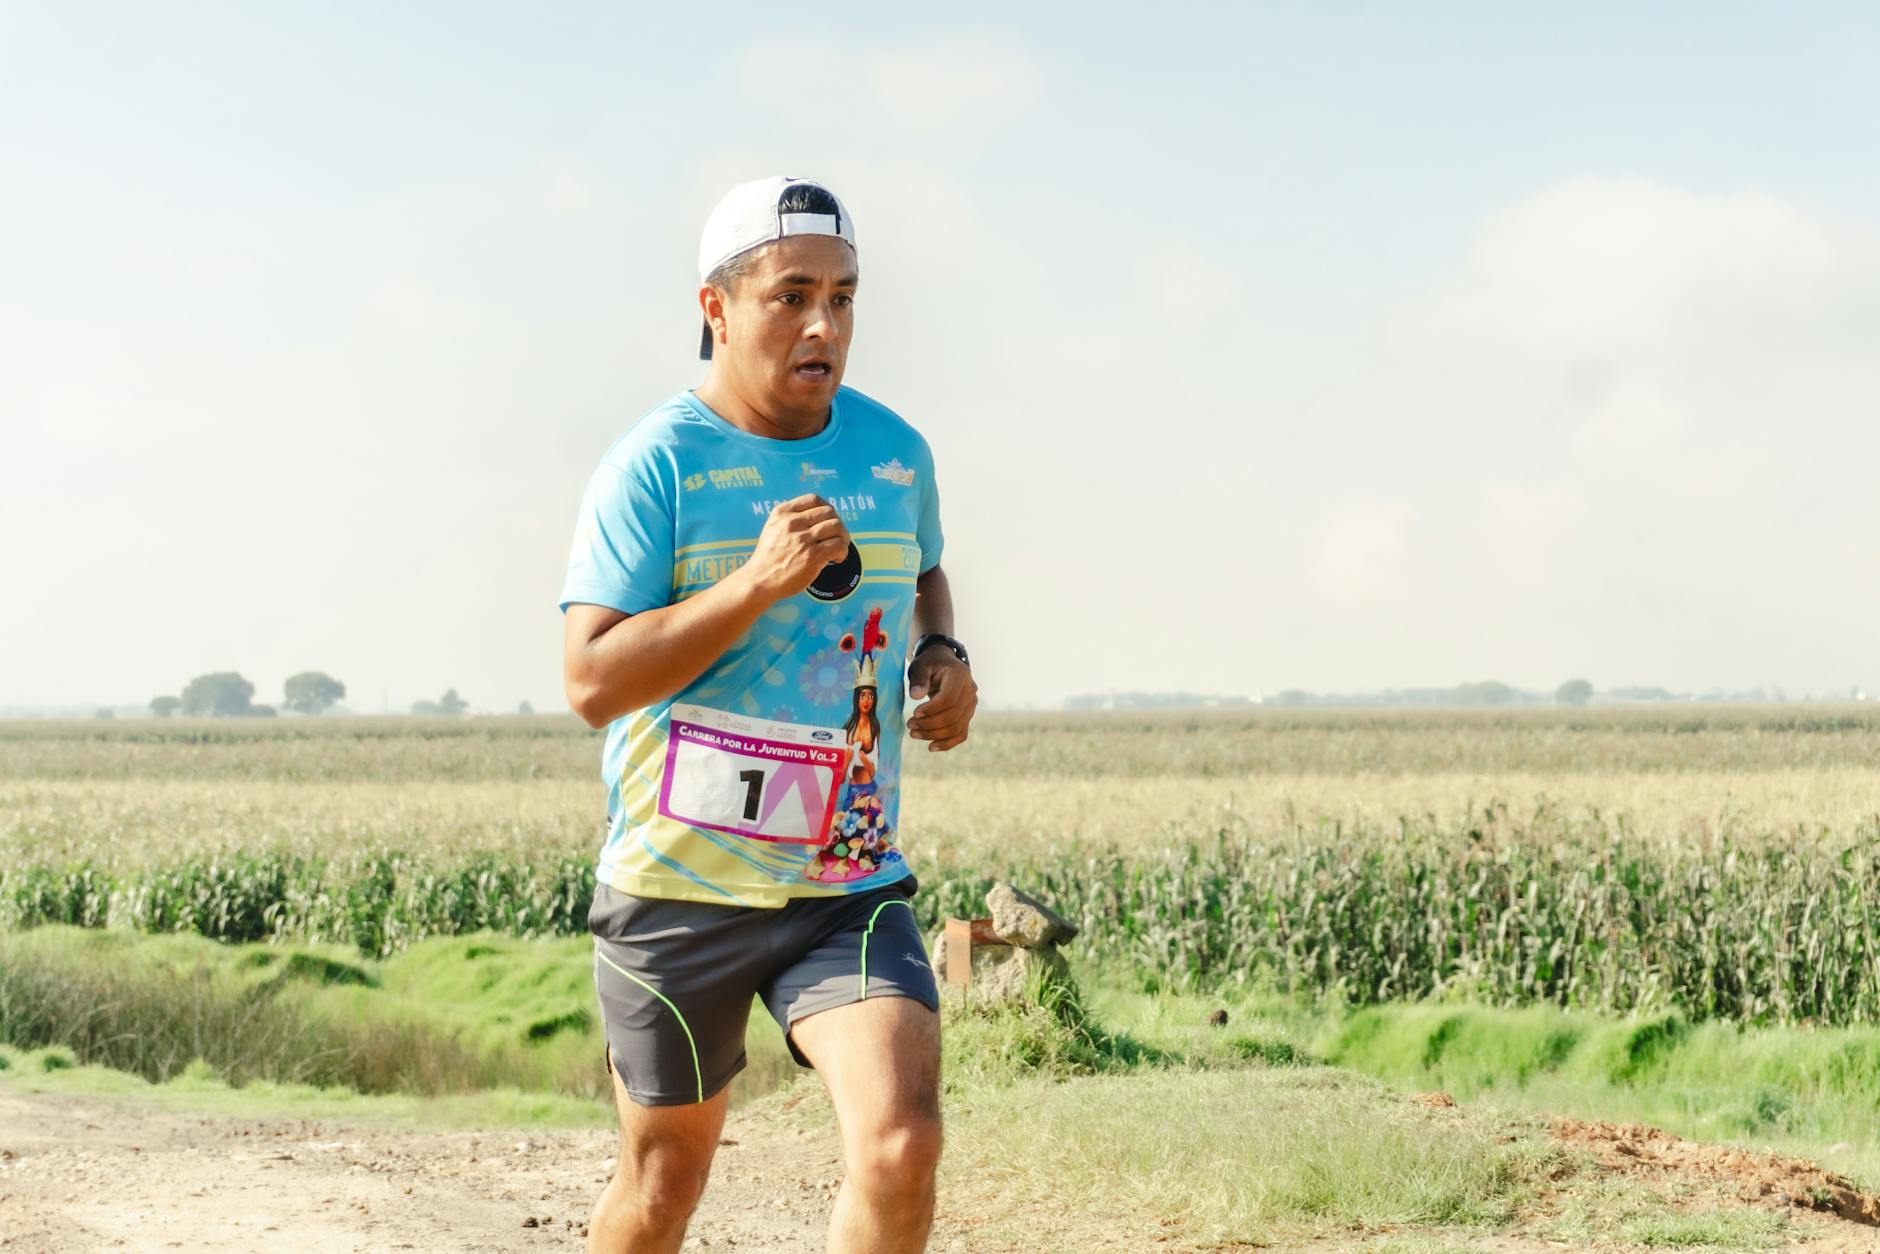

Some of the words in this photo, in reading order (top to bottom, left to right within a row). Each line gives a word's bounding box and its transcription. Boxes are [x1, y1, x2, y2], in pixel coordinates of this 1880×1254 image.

[708, 466, 762, 483] CAPITAL
[828, 492, 876, 511] RATÓN
[679, 725, 721, 744] CARRERA
[722, 738, 742, 749] POR
[743, 742, 756, 752] LA
[758, 743, 807, 759] JUVENTUD
[814, 731, 831, 740] Ford
[740, 769, 765, 821] 1
